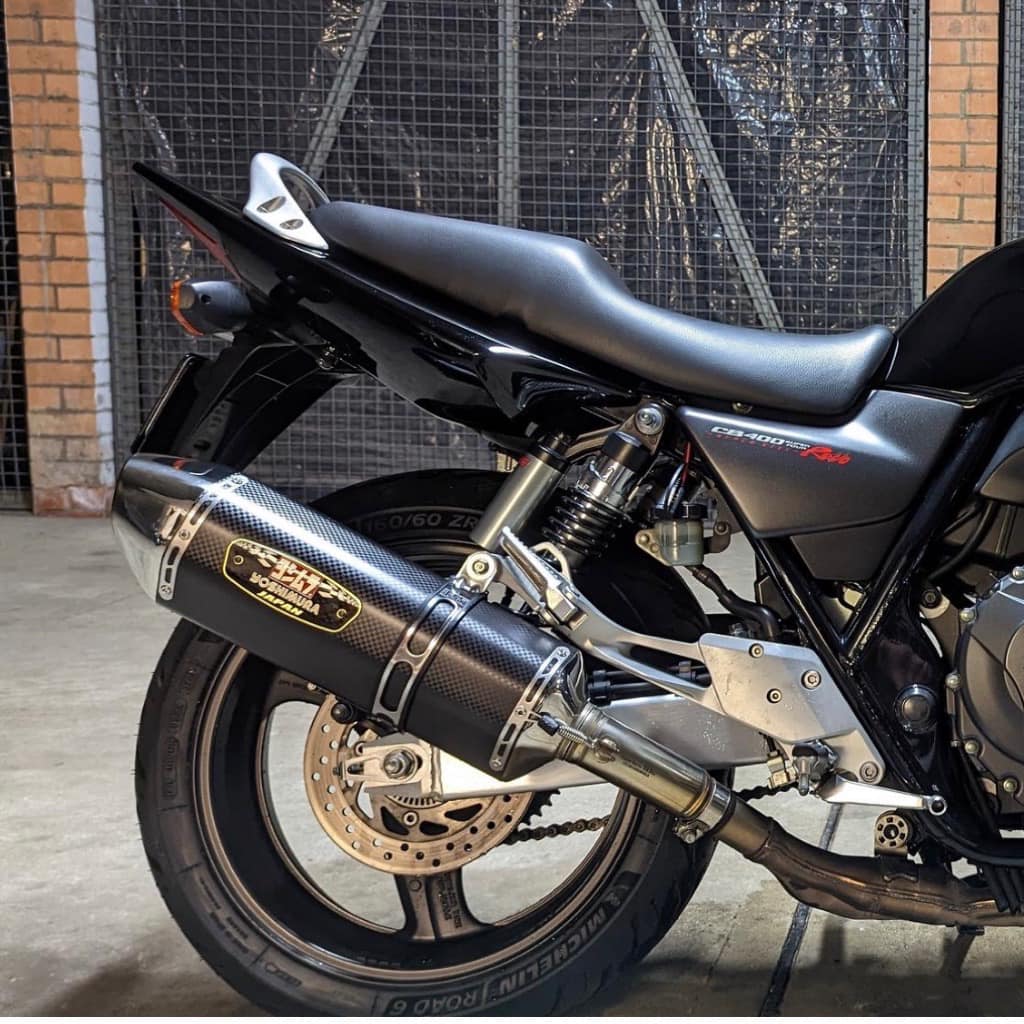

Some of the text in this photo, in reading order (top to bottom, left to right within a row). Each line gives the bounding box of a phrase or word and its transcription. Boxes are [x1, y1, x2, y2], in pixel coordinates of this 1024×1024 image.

[711, 426, 785, 445] CB400
[249, 571, 320, 616] YOSHIMURA
[256, 590, 304, 616] JAPAN
[499, 907, 607, 995] MICHELIN
[414, 992, 477, 1015] ROAD
